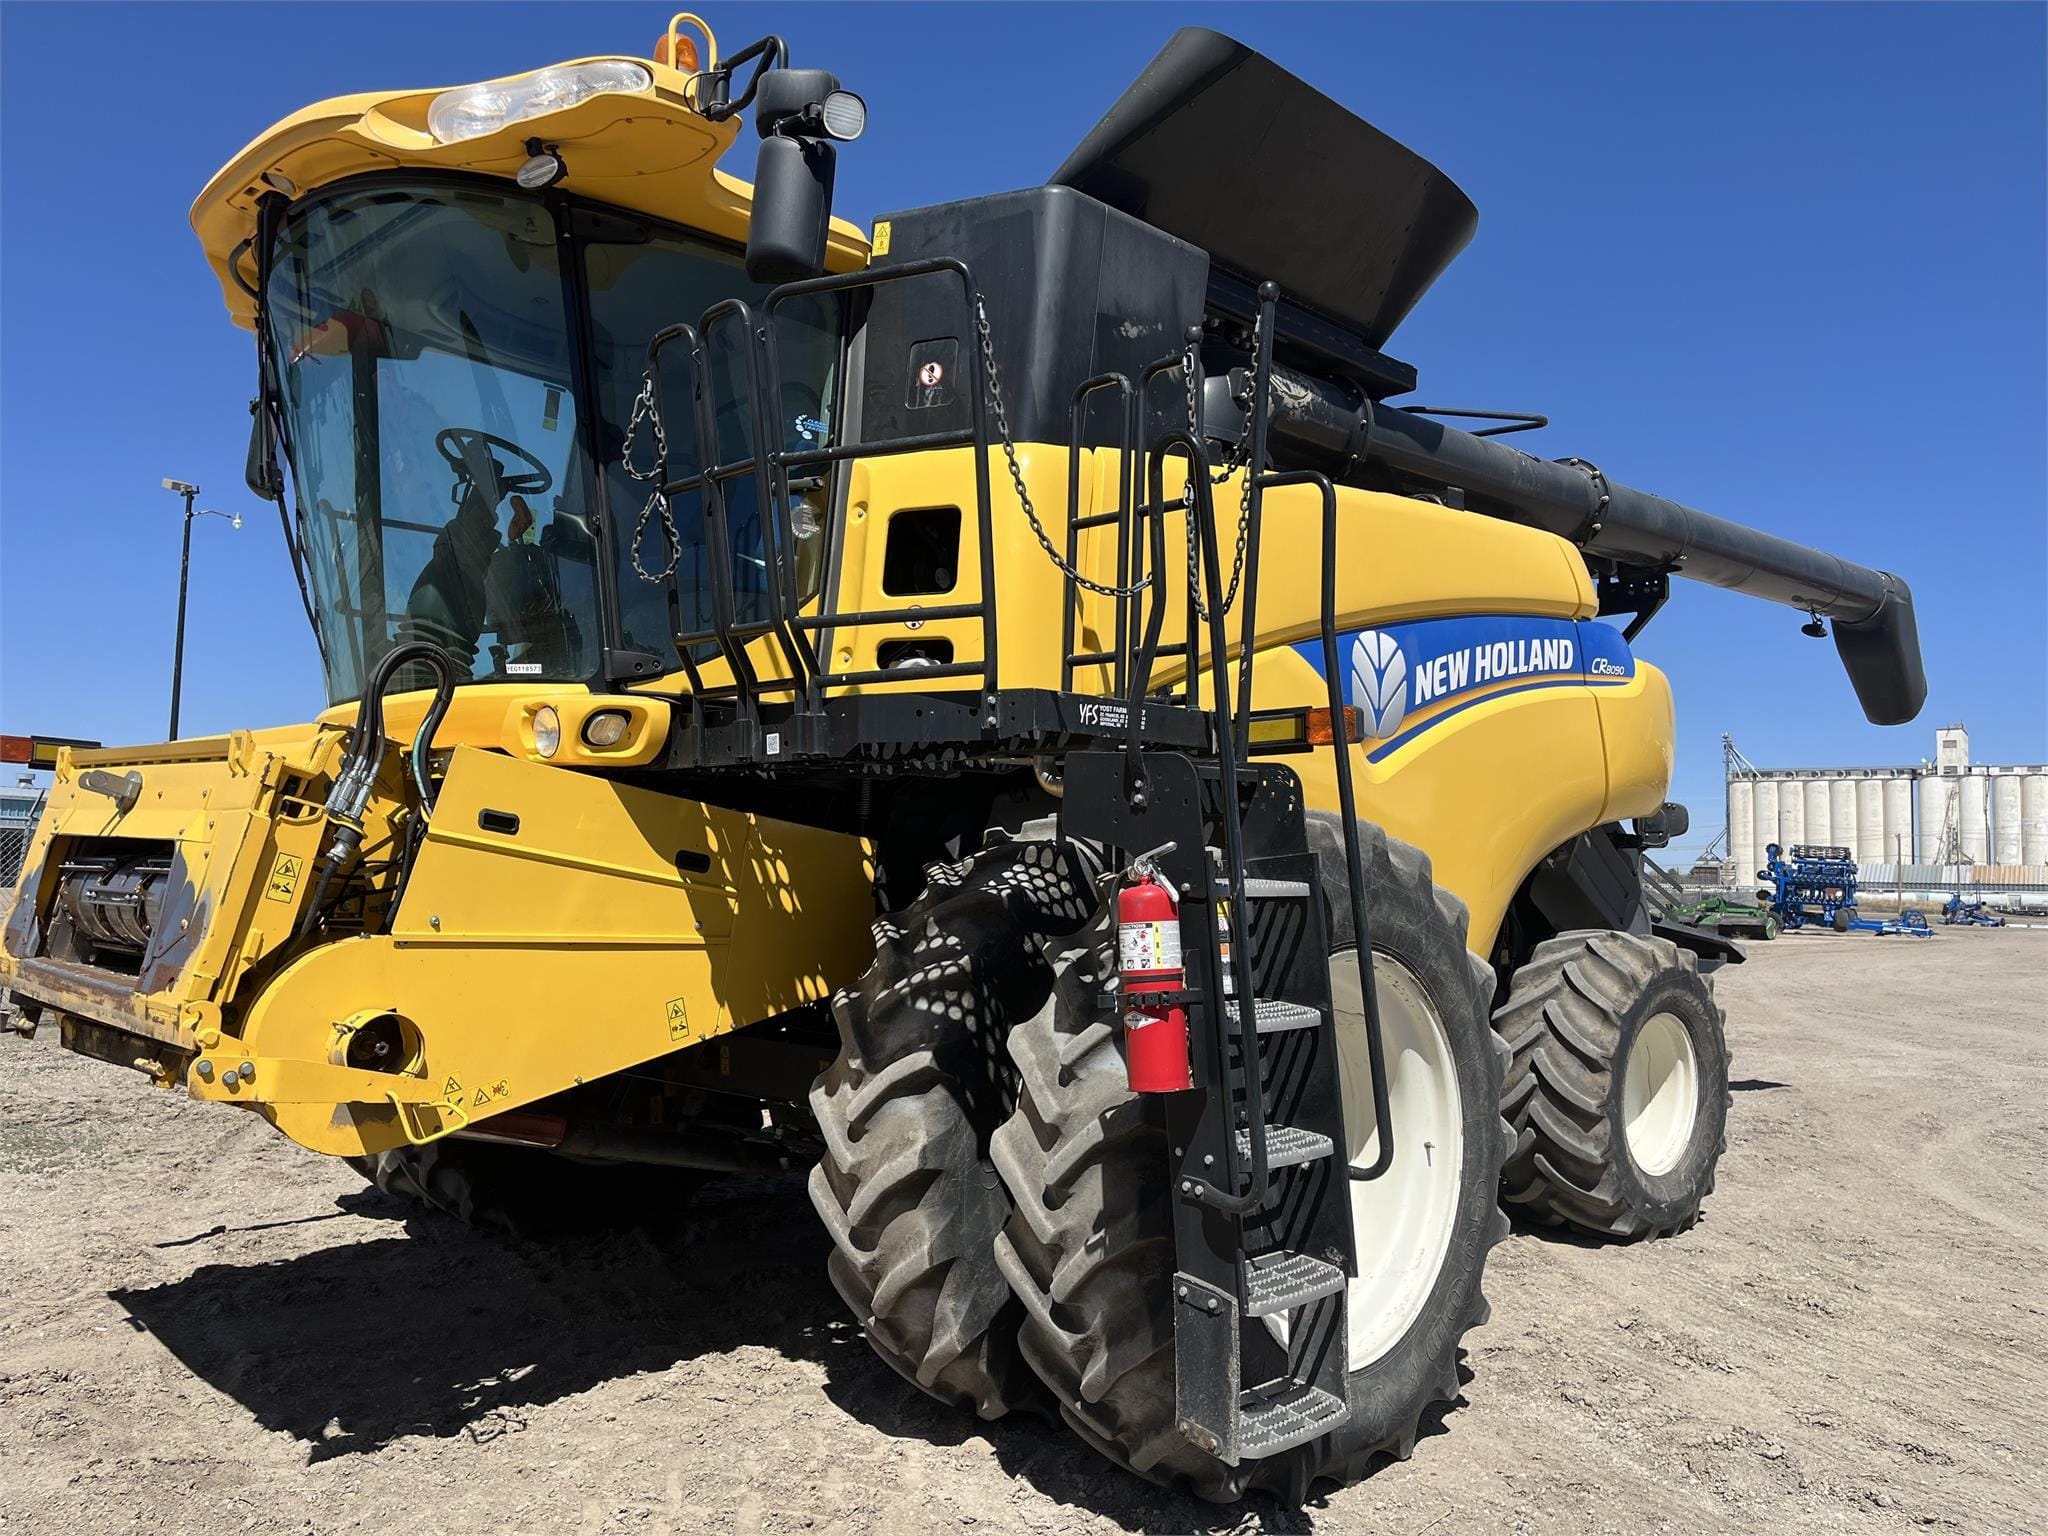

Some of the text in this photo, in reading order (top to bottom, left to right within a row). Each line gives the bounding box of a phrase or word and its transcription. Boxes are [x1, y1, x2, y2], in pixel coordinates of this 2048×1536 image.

[1415, 638, 1574, 705] NEW HOLLAND
[1591, 657, 1625, 676] CR8090
[1079, 703, 1099, 725] YFS
